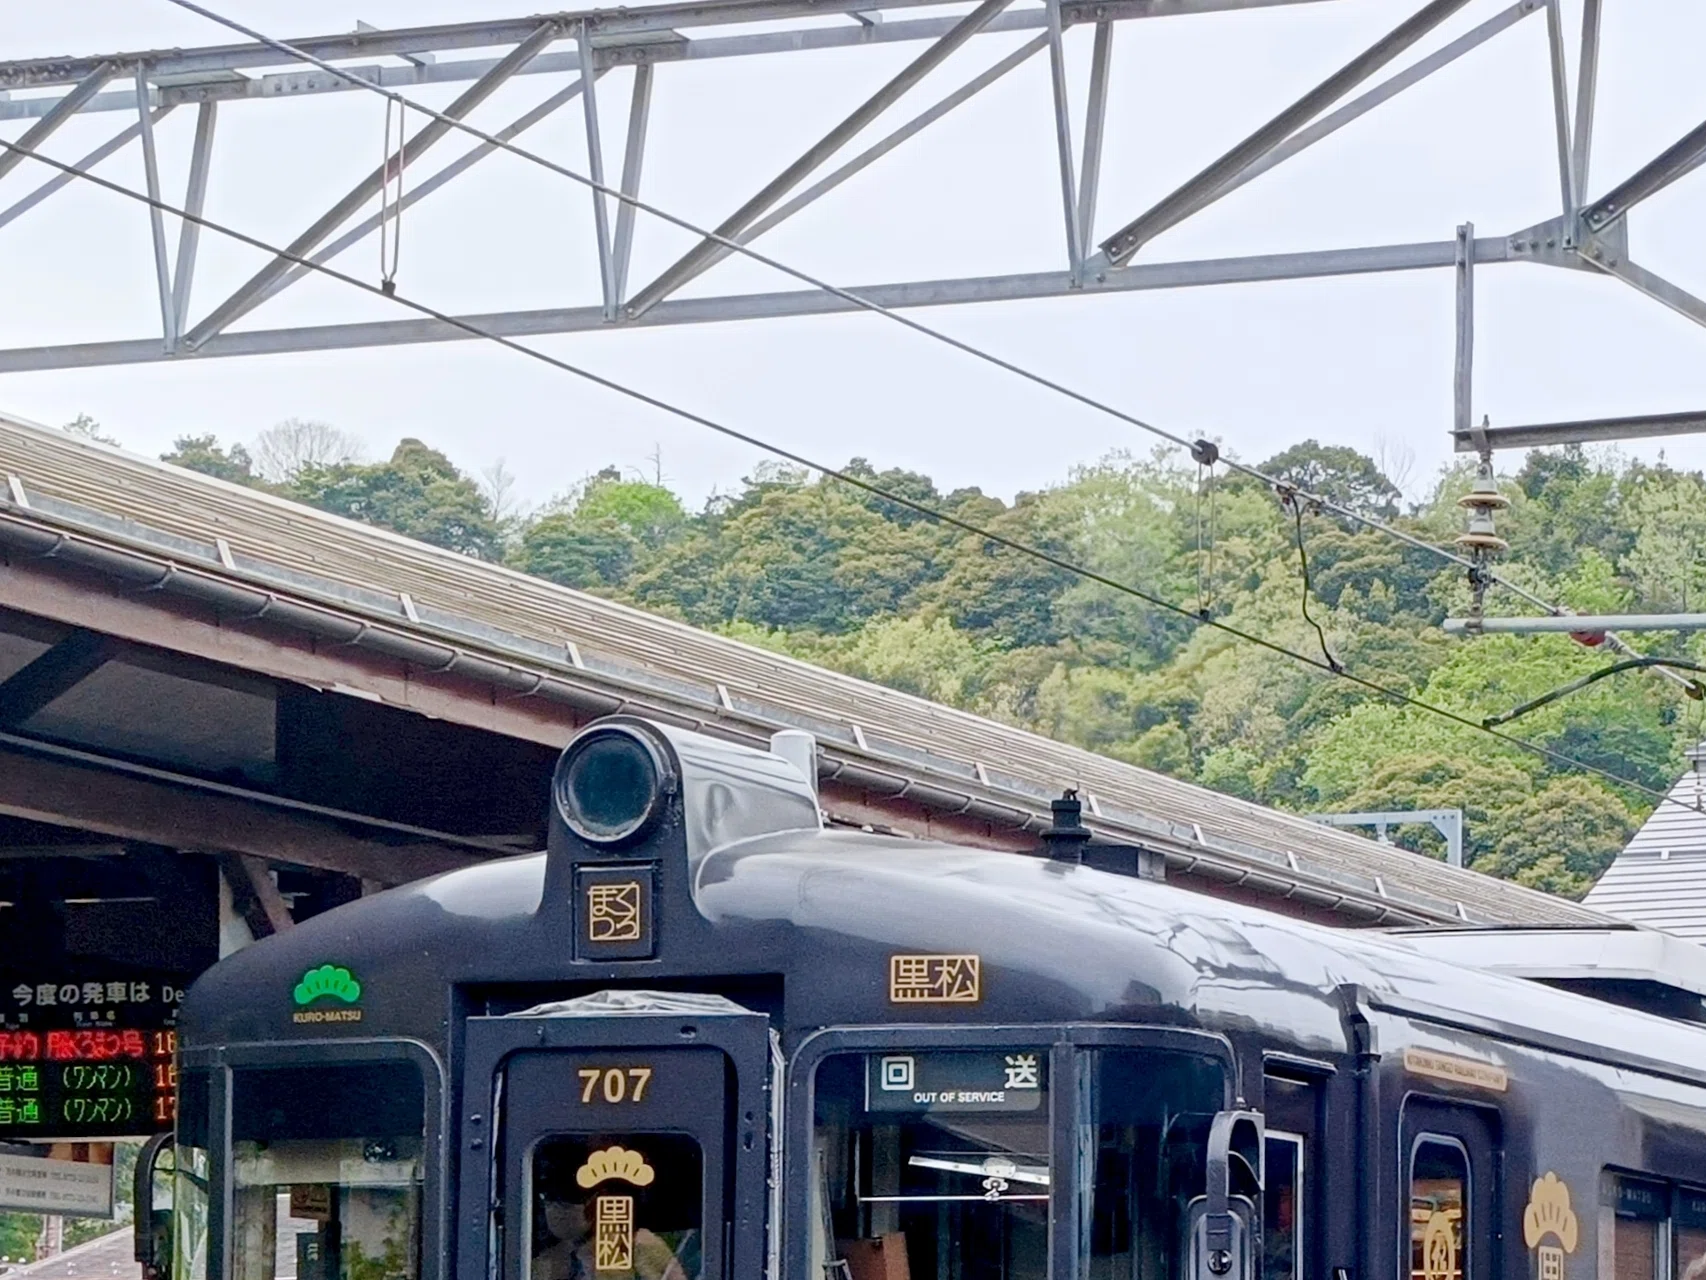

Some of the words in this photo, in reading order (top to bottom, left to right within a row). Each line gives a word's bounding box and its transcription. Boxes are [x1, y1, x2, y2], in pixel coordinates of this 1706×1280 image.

[890, 955, 980, 1002] 黒松
[12, 982, 151, 1007] 今度の発車は
[293, 1010, 362, 1023] KURO-MATSU
[0, 1065, 39, 1092] 普通
[578, 1068, 652, 1104] 707
[0, 1097, 40, 1124] 普通
[914, 1092, 940, 1104] OUT
[941, 1092, 956, 1103] OF
[958, 1091, 1005, 1103] SERVICE
[596, 1196, 633, 1270] 黒松
